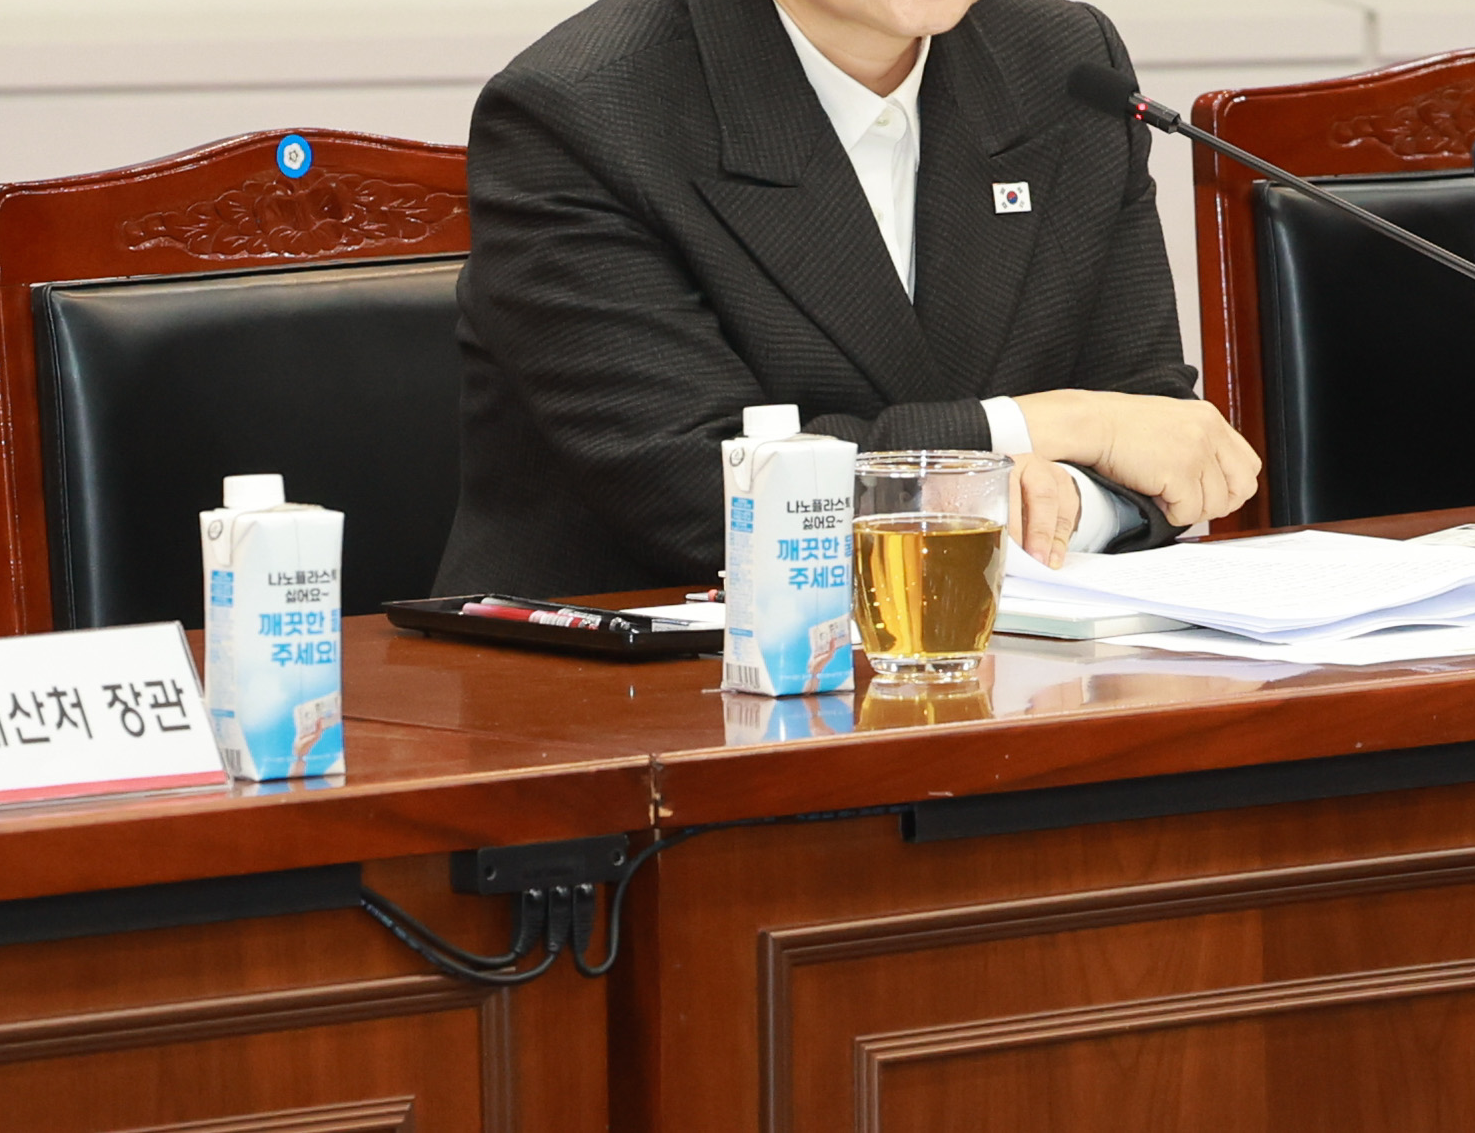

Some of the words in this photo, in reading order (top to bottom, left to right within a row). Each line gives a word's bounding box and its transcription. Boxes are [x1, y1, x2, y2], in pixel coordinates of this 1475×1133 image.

[776, 536, 840, 562] 깨끗한
[258, 610, 326, 637] 깨끗한
[101, 678, 193, 739] 장관
